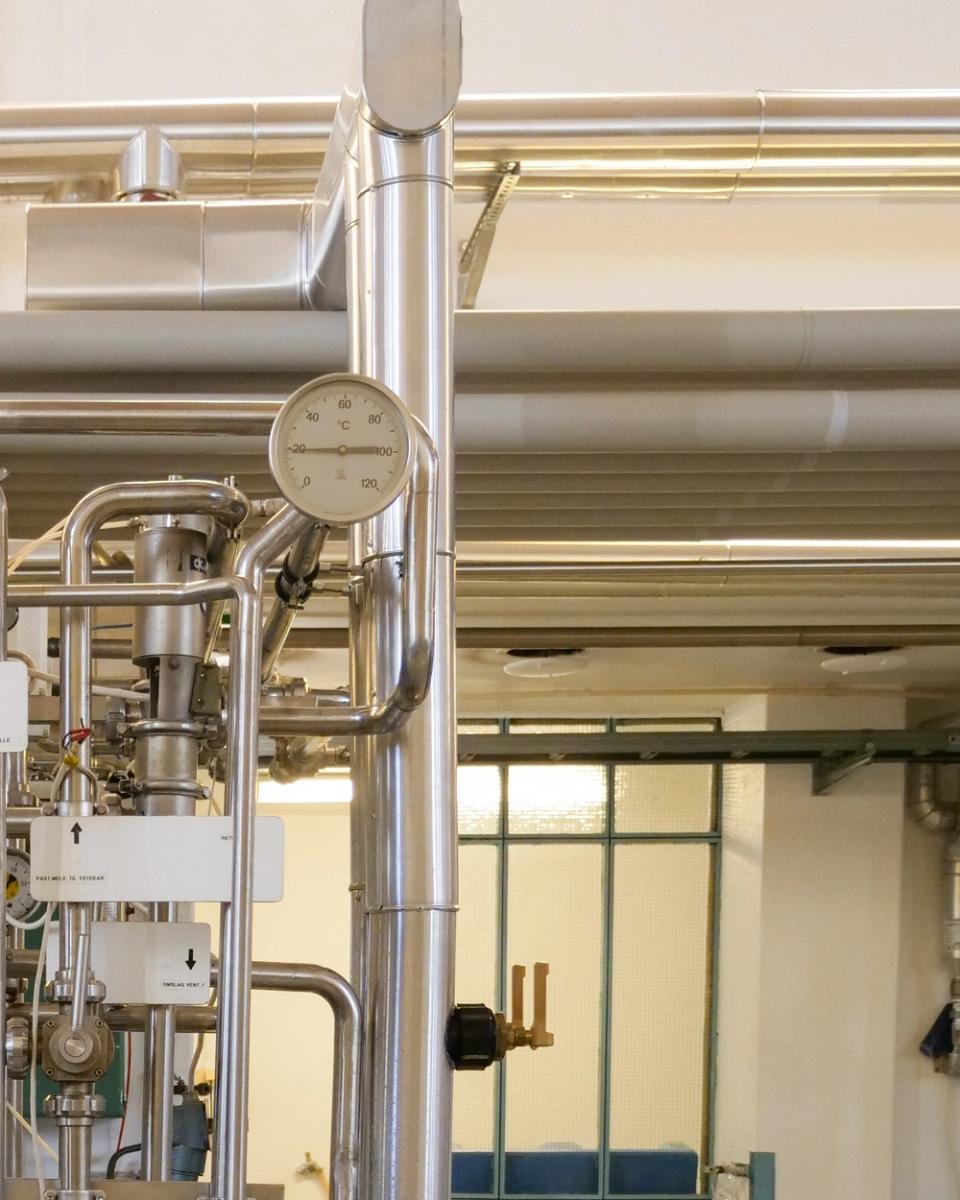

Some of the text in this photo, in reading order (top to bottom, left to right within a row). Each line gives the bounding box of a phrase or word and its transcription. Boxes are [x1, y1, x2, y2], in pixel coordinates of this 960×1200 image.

[338, 400, 352, 409] 60
[306, 412, 319, 422] 40
[368, 414, 381, 424] 80
[376, 446, 393, 456] 100
[303, 476, 311, 486] 0
[361, 478, 377, 488] 120
